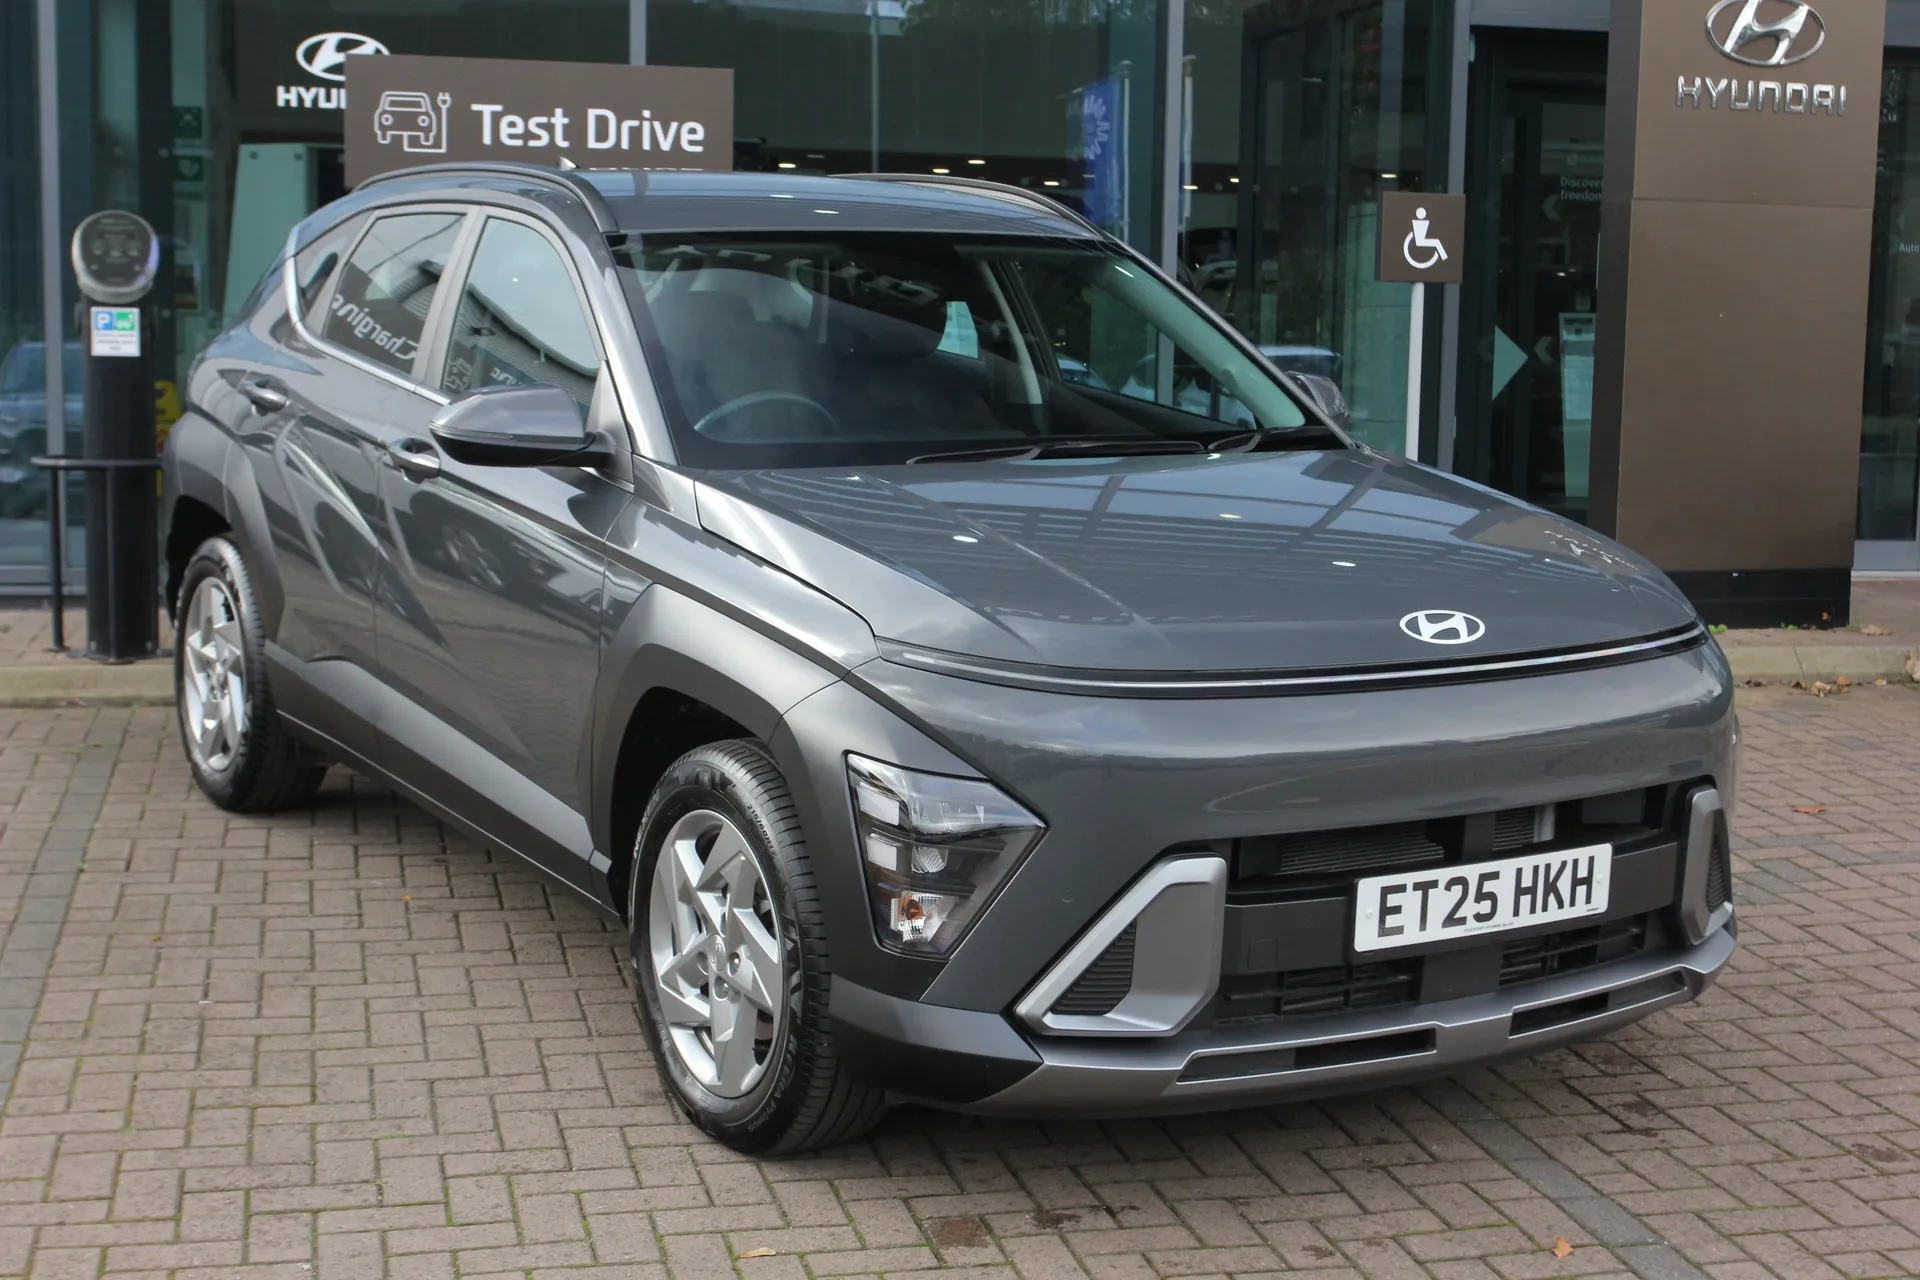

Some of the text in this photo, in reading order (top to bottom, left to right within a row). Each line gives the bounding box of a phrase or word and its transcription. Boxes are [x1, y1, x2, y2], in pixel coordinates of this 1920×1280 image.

[1676, 75, 1847, 116] HYUNDAI
[470, 103, 704, 152] Test Drive
[1377, 855, 1595, 938] ET25 HKH
